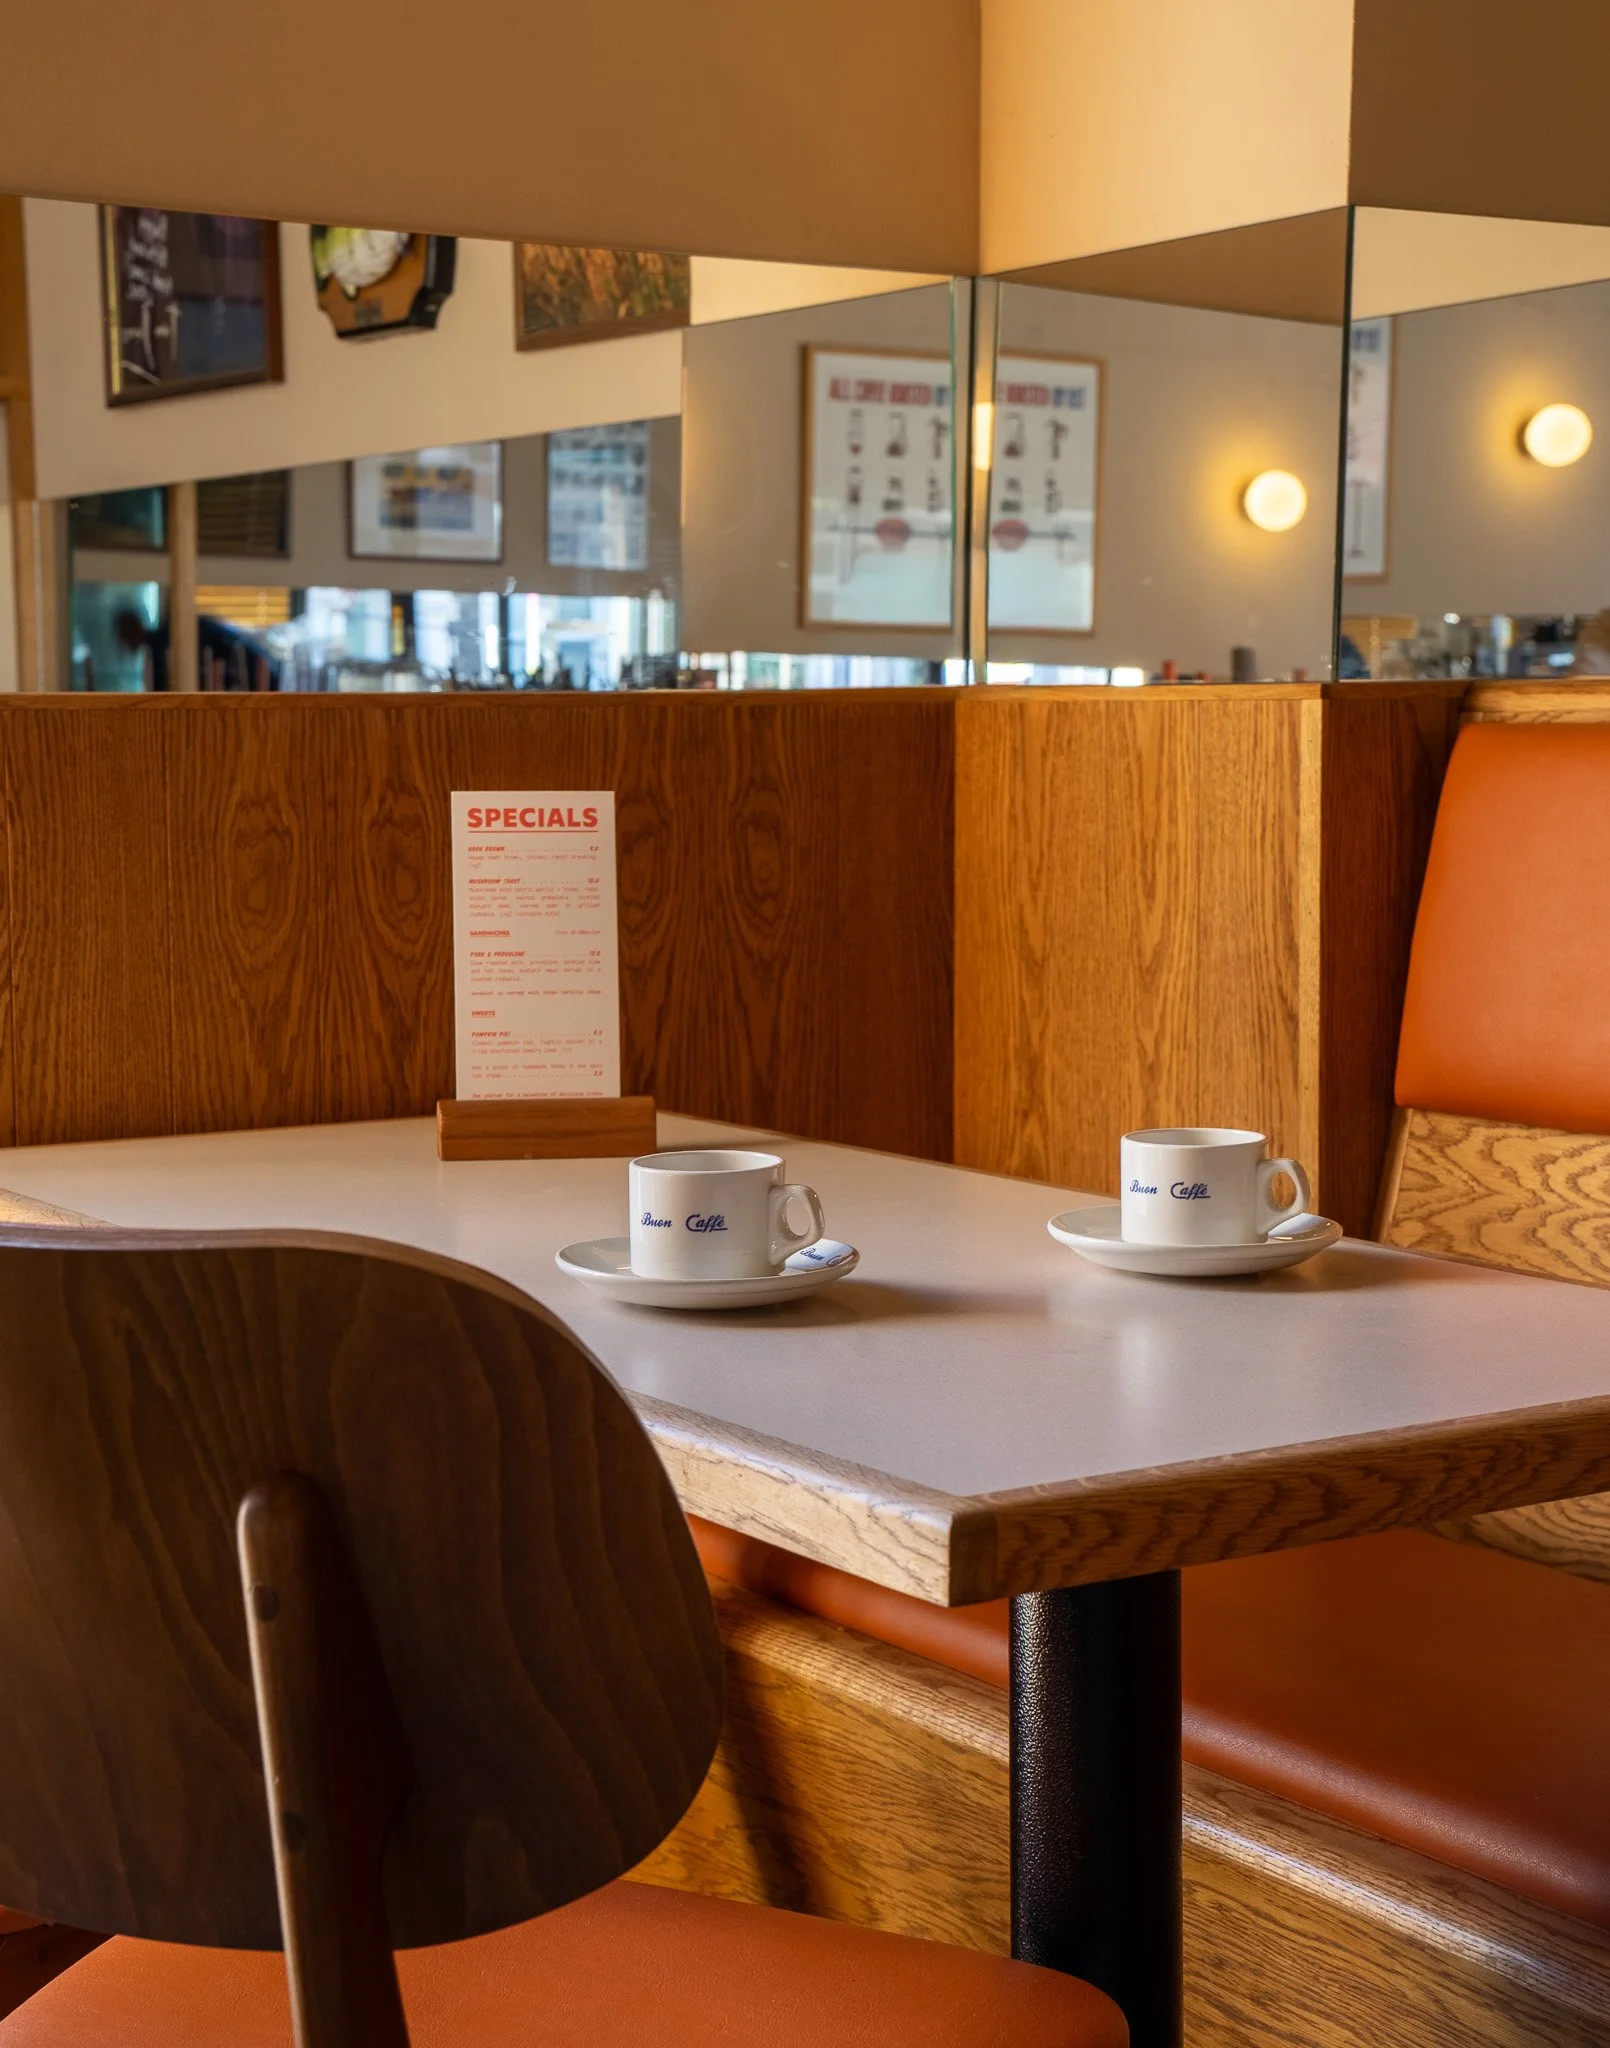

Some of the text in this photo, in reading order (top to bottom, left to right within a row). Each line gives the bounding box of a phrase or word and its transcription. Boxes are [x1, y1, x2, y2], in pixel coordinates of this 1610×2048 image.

[467, 808, 598, 828] SPECIALS
[1129, 1179, 1158, 1196] Buon
[641, 1211, 672, 1229] Buon
[799, 1247, 825, 1262] Buon
